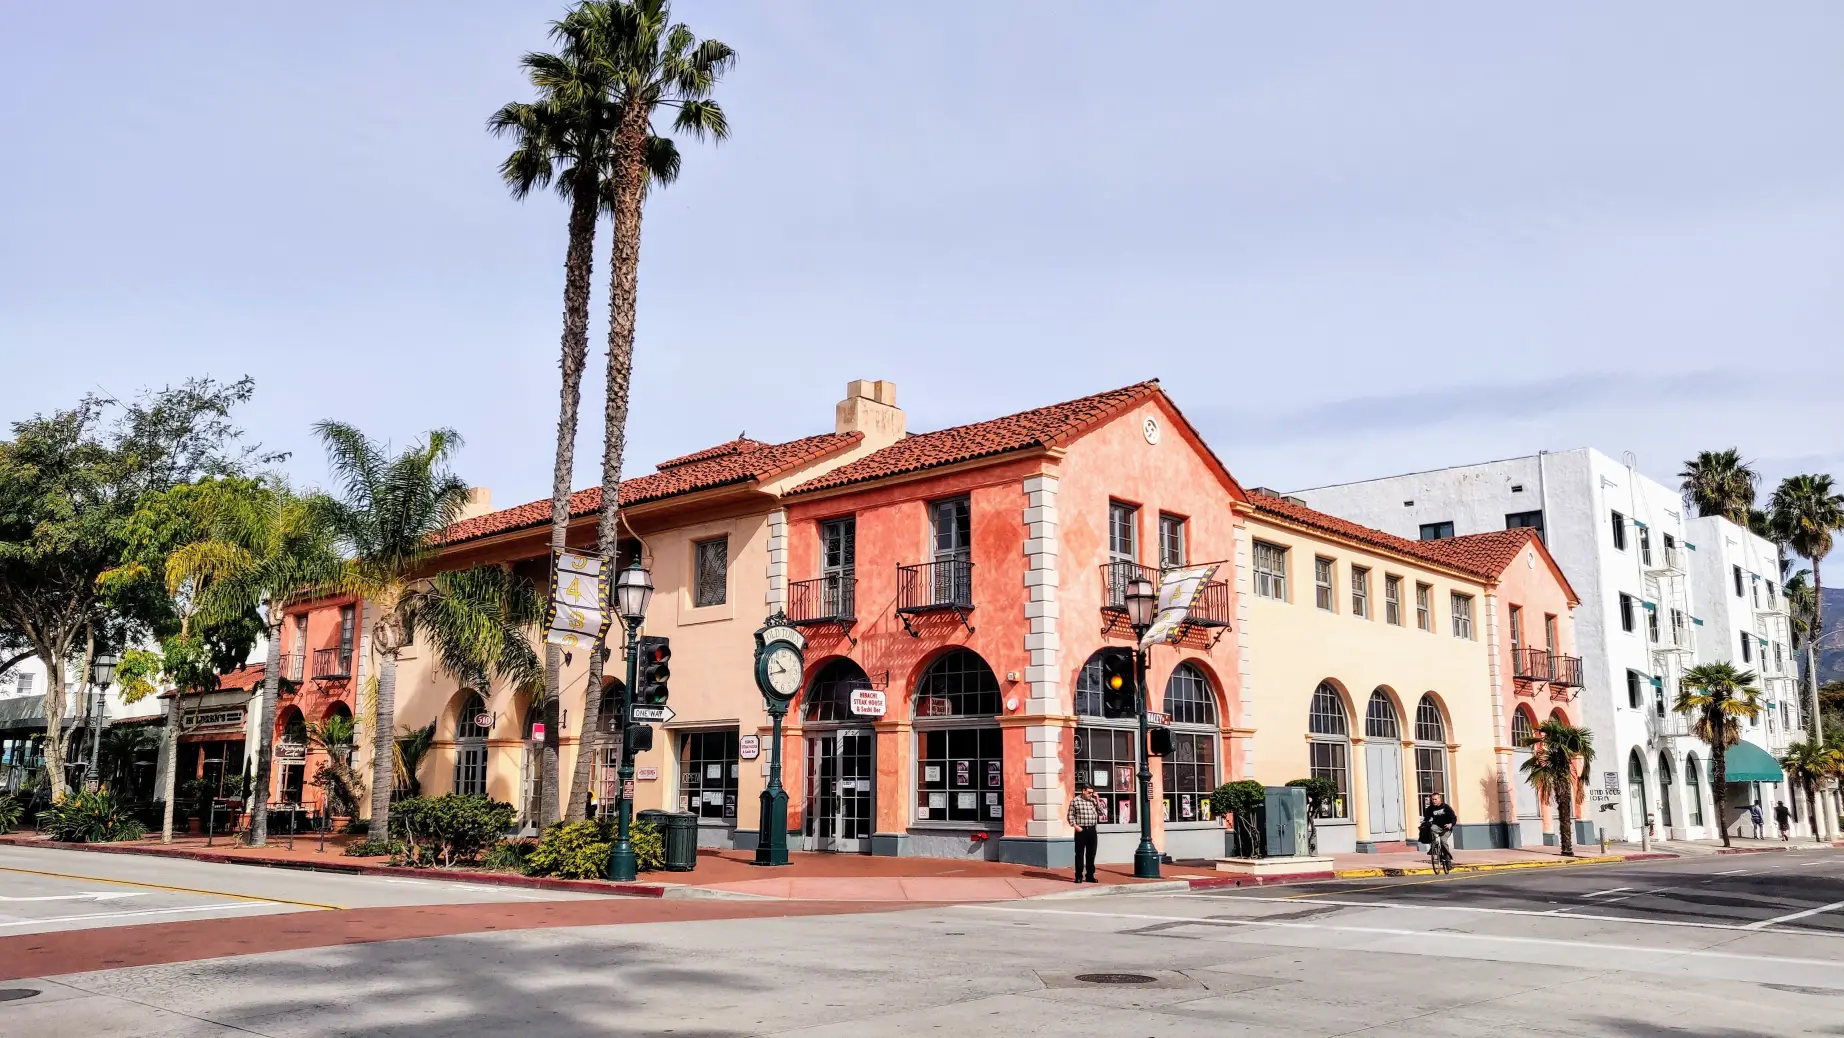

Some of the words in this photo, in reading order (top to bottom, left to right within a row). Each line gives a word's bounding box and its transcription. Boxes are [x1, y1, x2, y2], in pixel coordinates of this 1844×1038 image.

[566, 577, 581, 603] 4
[766, 627, 780, 641] OLD
[650, 710, 663, 718] WAY
[477, 716, 491, 724] 510
[683, 773, 700, 783] OPEN
